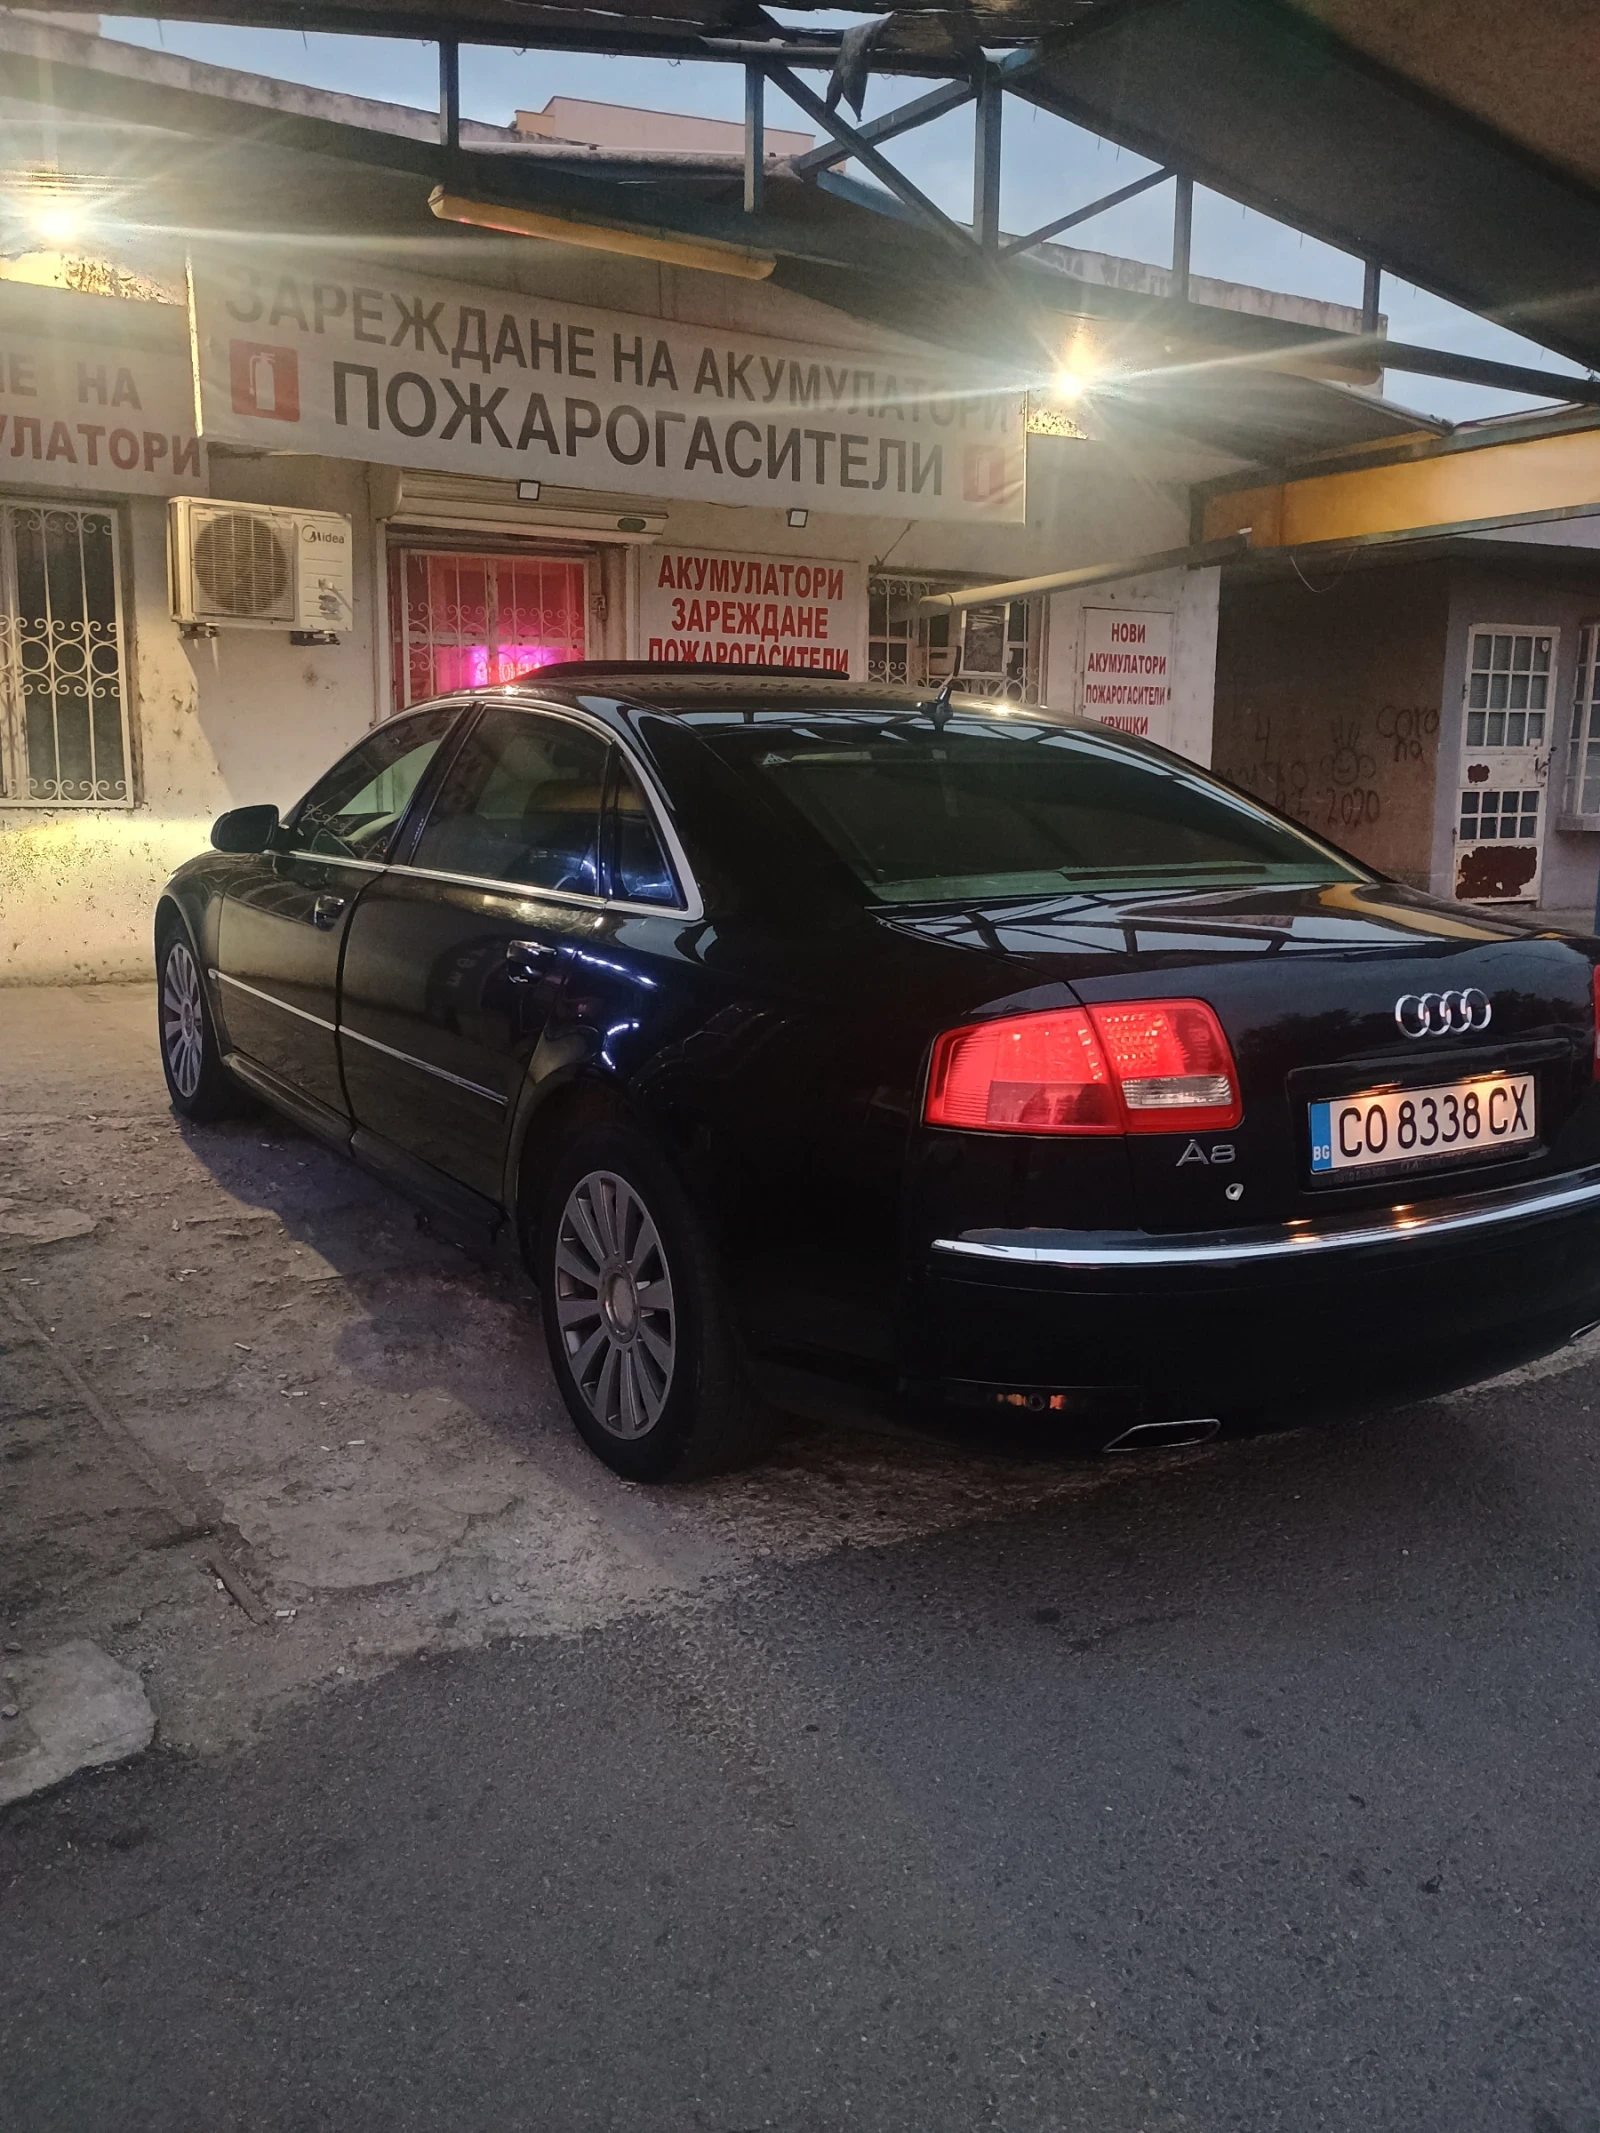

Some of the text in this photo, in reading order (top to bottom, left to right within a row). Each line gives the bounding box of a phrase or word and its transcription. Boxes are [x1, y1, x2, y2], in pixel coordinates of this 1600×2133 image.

[225, 263, 1008, 432] ЗАРЕЖДАНЕ НА АКУМУЛАТОРИ
[76, 360, 142, 410] НА
[333, 361, 943, 496] ПОЖАРОГАСИТЕЛИ
[299, 518, 345, 545] Midea
[657, 555, 844, 601] АКУМУЛАТОРИ
[671, 597, 829, 643] ЗАРЕЖДАНЕ
[1111, 622, 1146, 643] НОВИ
[648, 638, 849, 673] ПОЖАРОГАСИТЕЛИ
[1087, 652, 1167, 675] АКУМУЛАТОРИ
[1085, 684, 1166, 706] ПОЖАРОГАСИТЕЛИ
[1338, 1104, 1388, 1158] CO
[1397, 1091, 1482, 1150] 8338
[1488, 1082, 1529, 1136] CX
[1176, 1138, 1237, 1168] A8
[1313, 1145, 1331, 1161] BG
